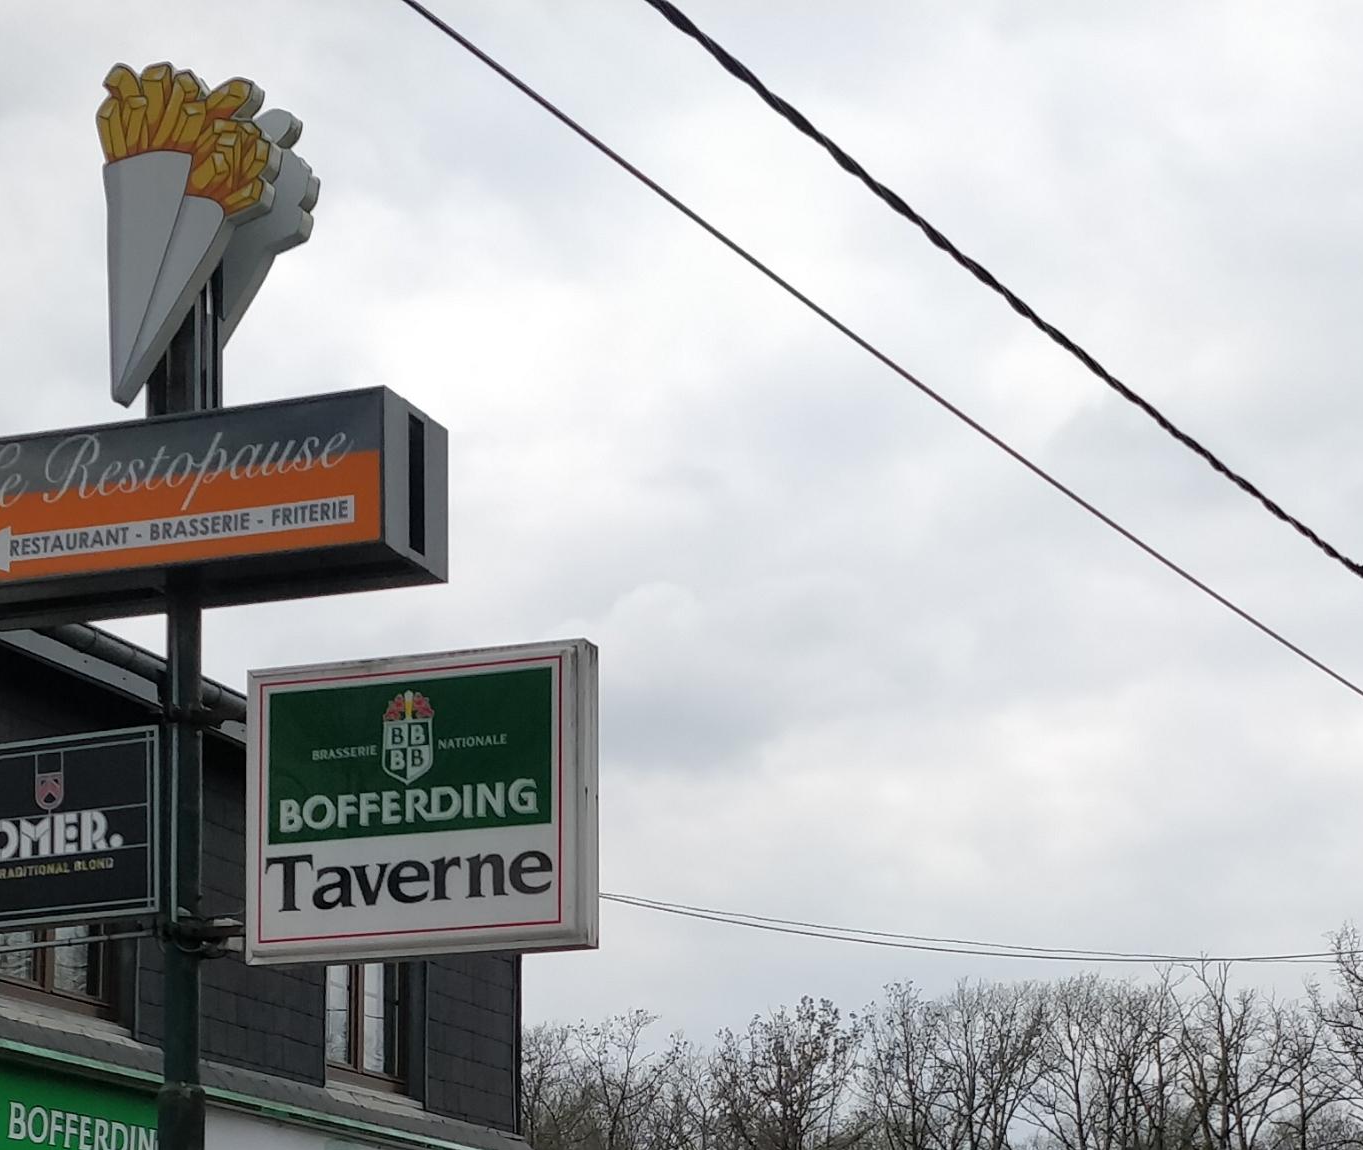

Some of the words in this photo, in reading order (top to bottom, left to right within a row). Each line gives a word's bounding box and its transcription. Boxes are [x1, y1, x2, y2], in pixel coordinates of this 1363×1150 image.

[43, 432, 352, 510] Restopause
[9, 527, 129, 557] RESTAURANT
[150, 513, 250, 541] BRASSERIE
[272, 499, 348, 525] FRITERIE
[312, 745, 377, 760] BRASSERIE
[438, 734, 507, 749] NATIONALE
[279, 778, 539, 833] BOFFERDING
[74, 857, 114, 871] BLOND
[265, 850, 552, 912] Taverne
